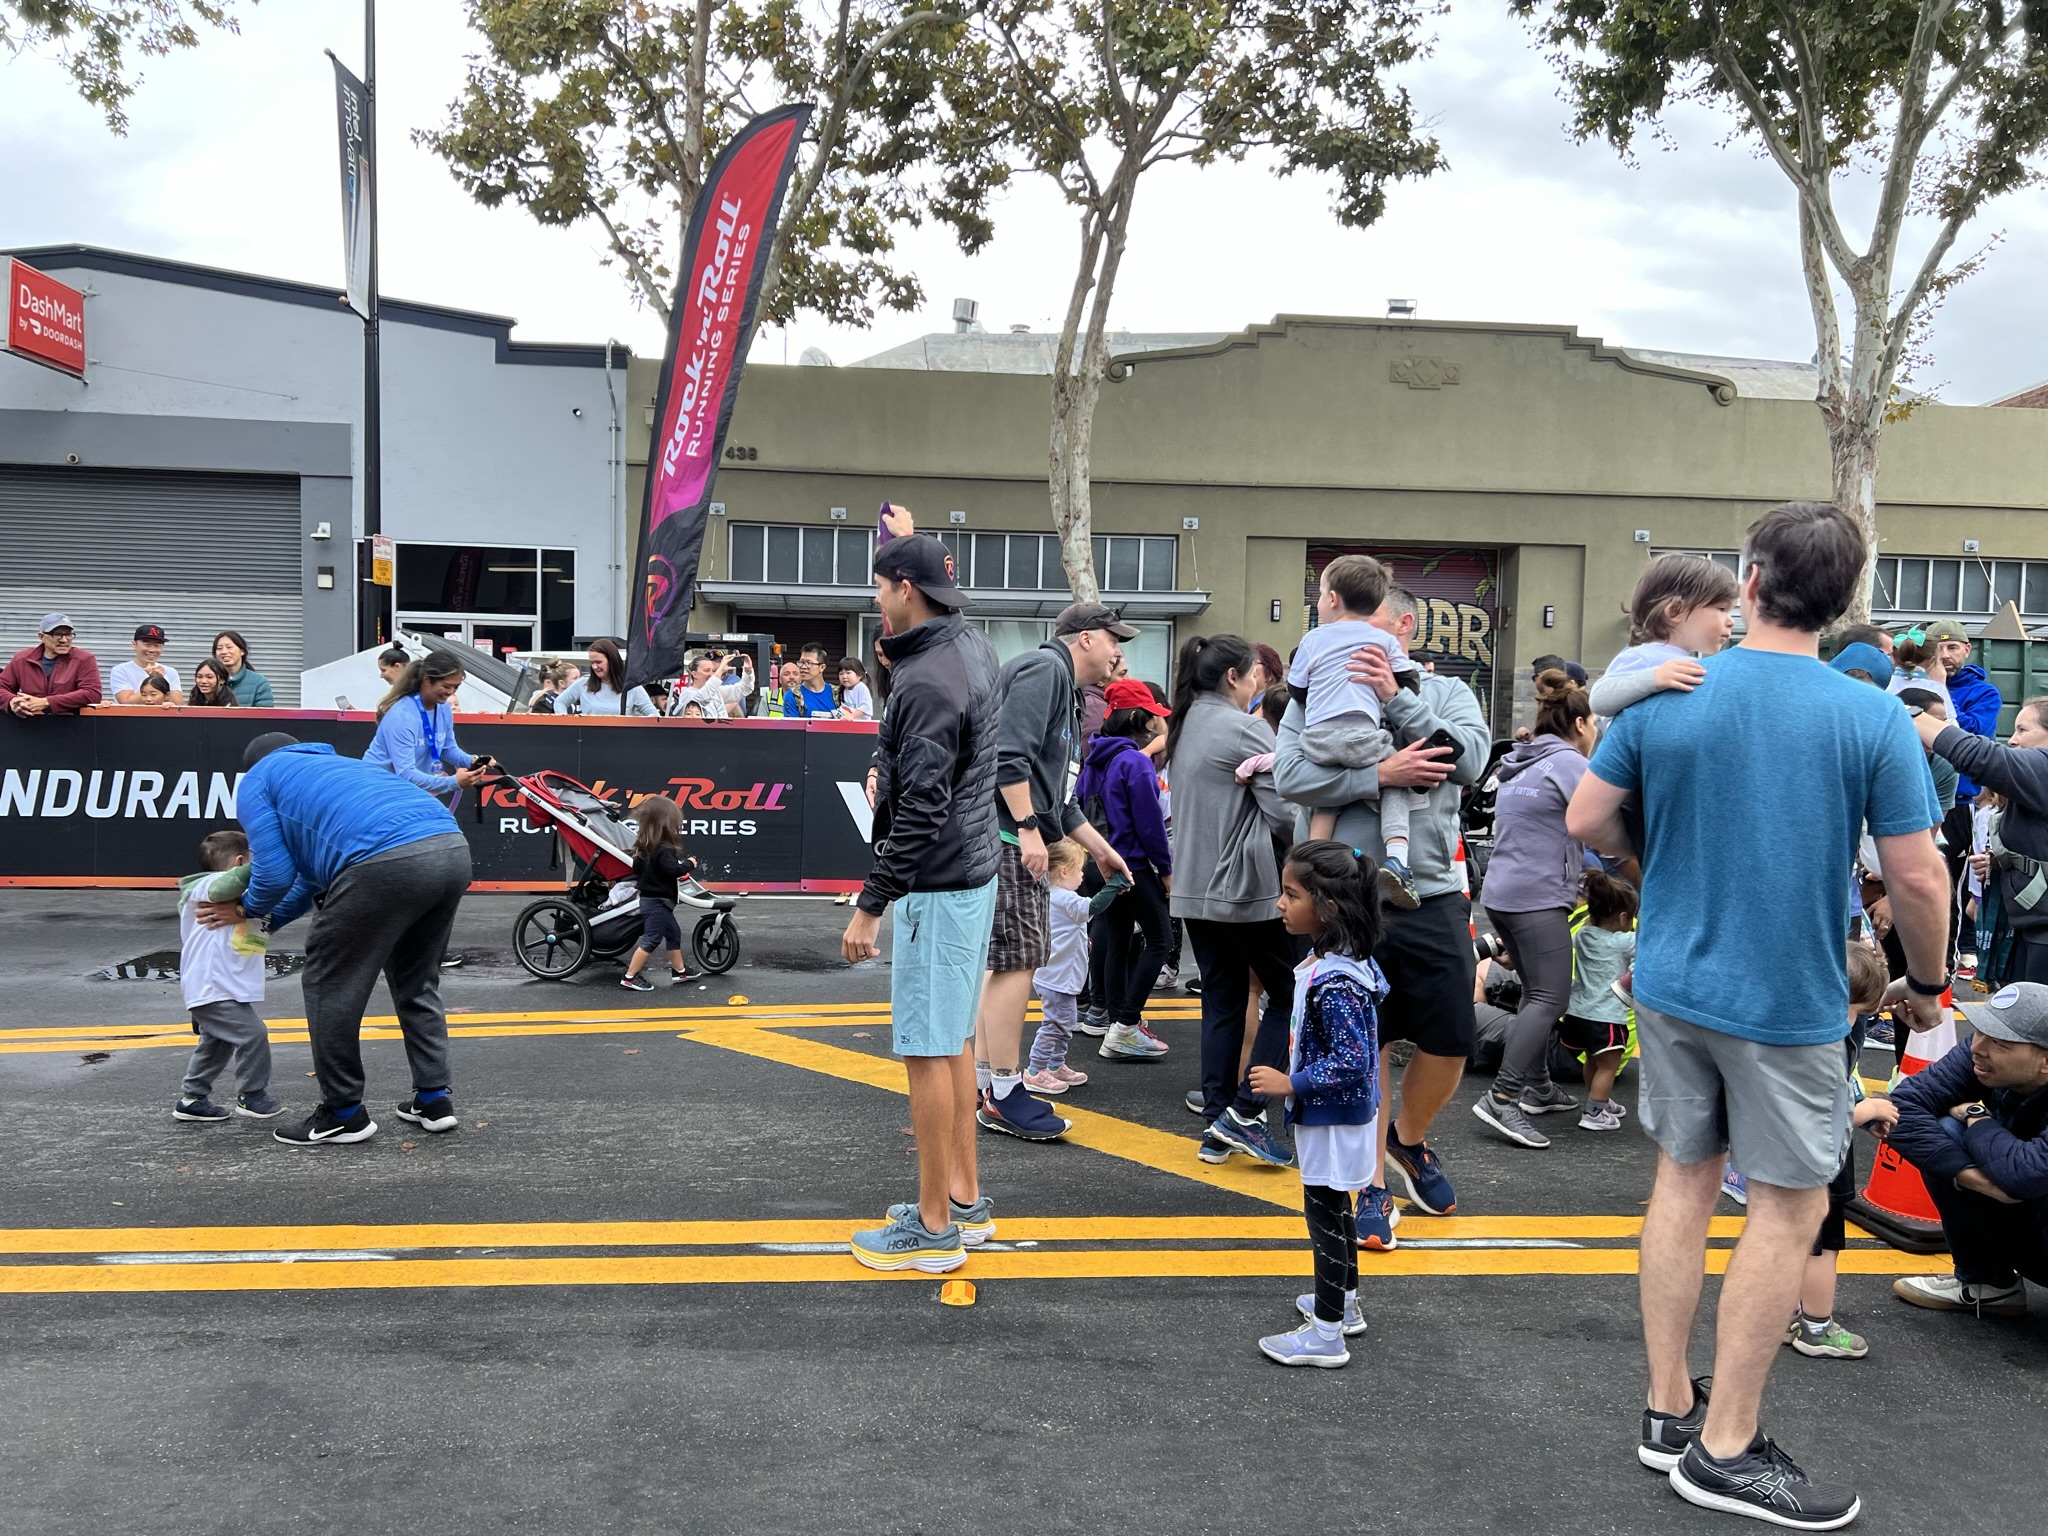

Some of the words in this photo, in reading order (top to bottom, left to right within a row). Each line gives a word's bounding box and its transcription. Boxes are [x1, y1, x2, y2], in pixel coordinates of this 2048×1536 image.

[350, 90, 362, 143] intel
[20, 283, 82, 334] DashMart
[19, 316, 28, 331] by
[43, 326, 82, 351] DOORDASH
[685, 332, 722, 457] RUNNING
[717, 223, 750, 322] SERIES
[661, 348, 706, 481] Rock
[725, 446, 758, 461] 438
[678, 819, 757, 836] ERIES
[887, 1238, 920, 1250] HOKA
